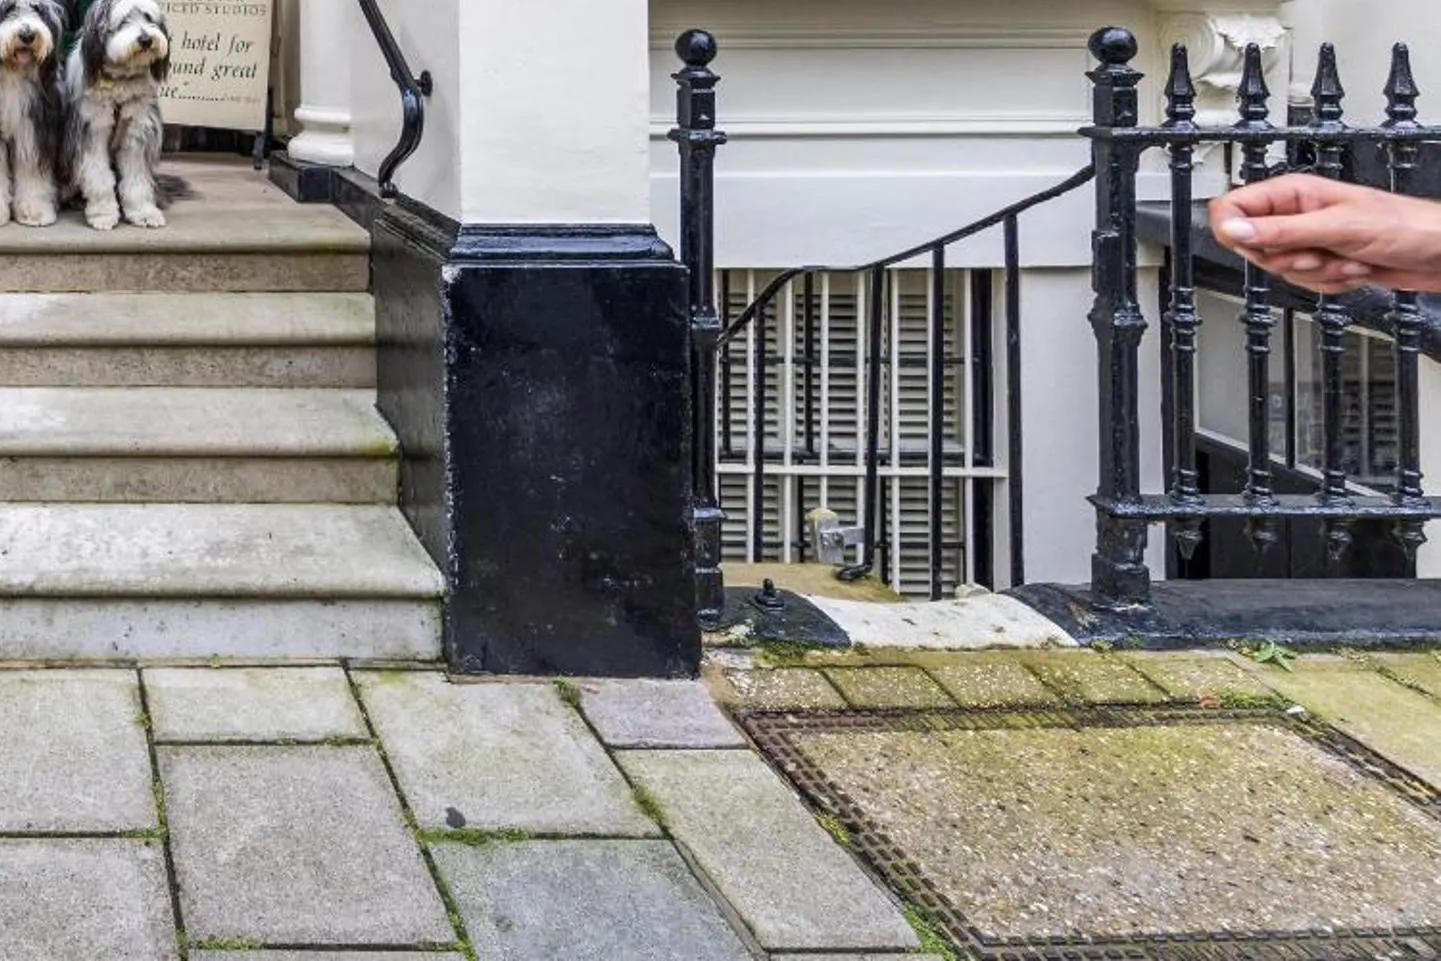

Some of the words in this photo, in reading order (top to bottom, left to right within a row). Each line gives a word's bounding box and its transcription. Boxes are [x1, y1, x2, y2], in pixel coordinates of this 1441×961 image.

[205, 3, 267, 16] STUDIOS
[181, 30, 220, 51] hotel
[227, 33, 255, 56] for
[211, 63, 257, 81] great
